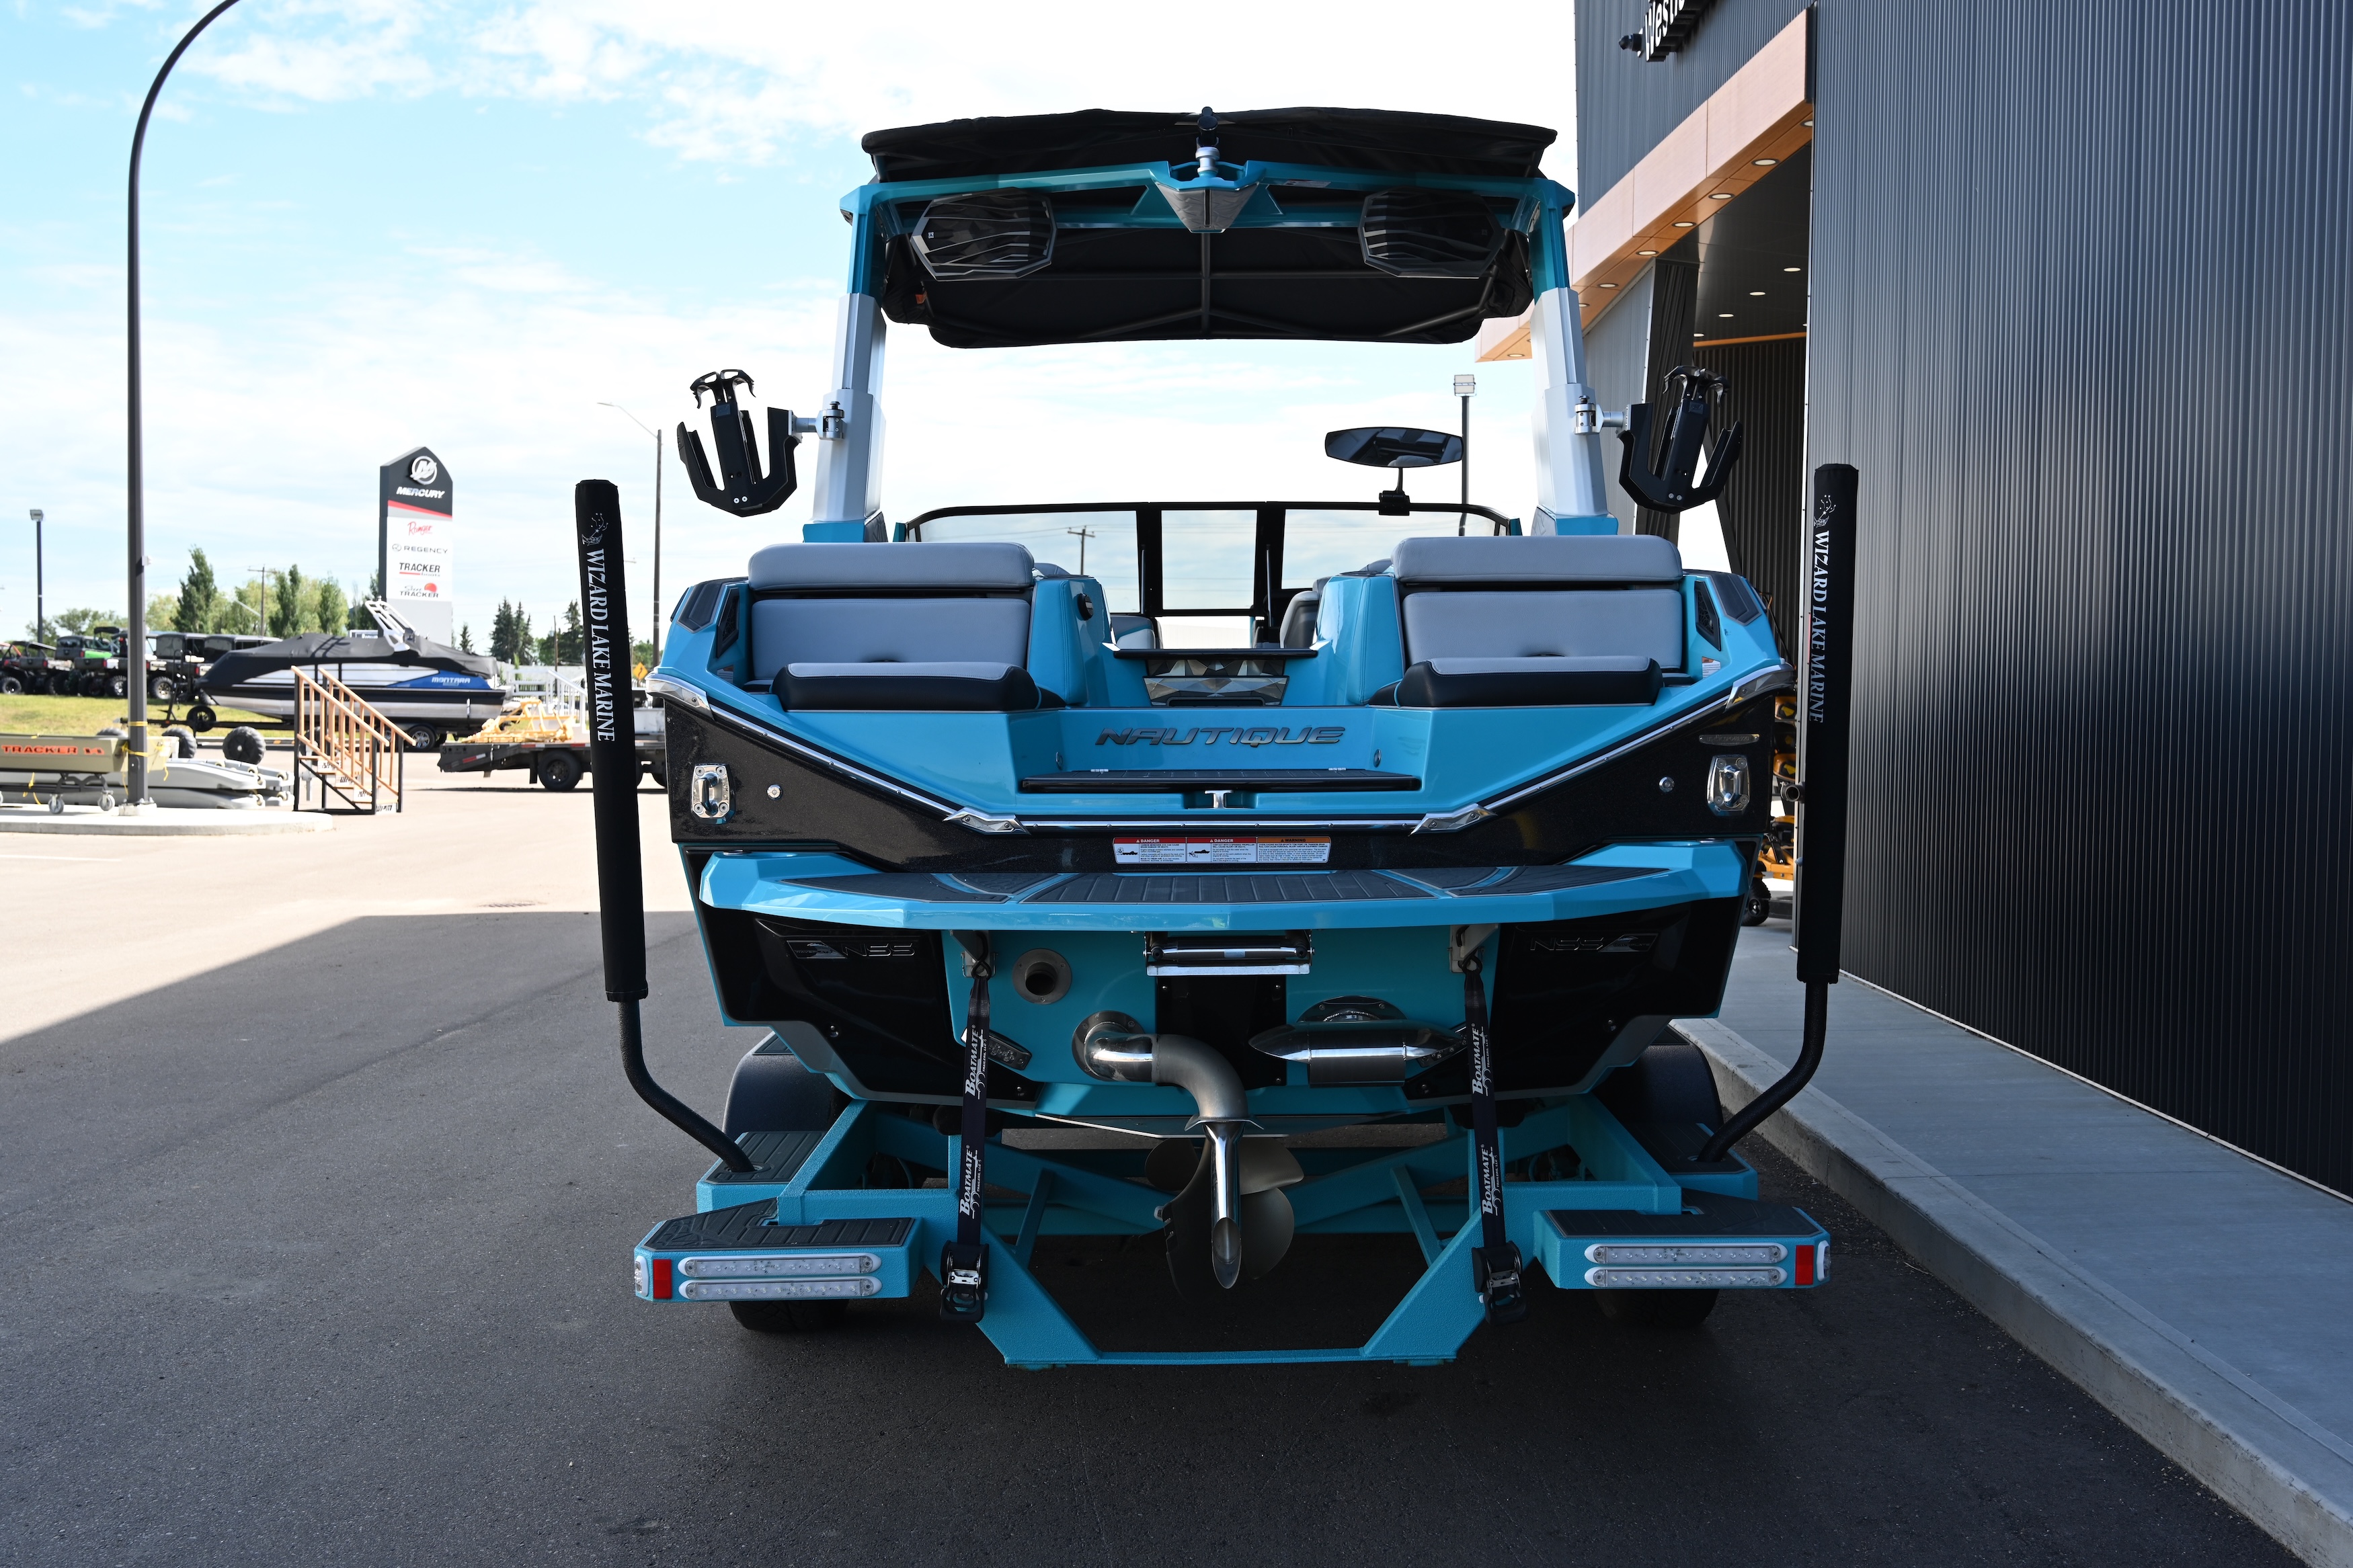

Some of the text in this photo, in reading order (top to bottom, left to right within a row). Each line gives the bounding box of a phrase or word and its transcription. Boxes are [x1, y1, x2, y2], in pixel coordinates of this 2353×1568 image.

[396, 487, 445, 499] MERCURY
[407, 522, 432, 536] Ranger
[404, 546, 448, 554] REGENCY
[399, 563, 440, 573] TRACKER
[1808, 530, 1829, 723] WIZARD LAKE MARINE
[586, 548, 615, 742] WIZARD LAKE MARINE
[1094, 726, 1345, 748] NAUTIQUE
[1, 745, 78, 754] TRACKER
